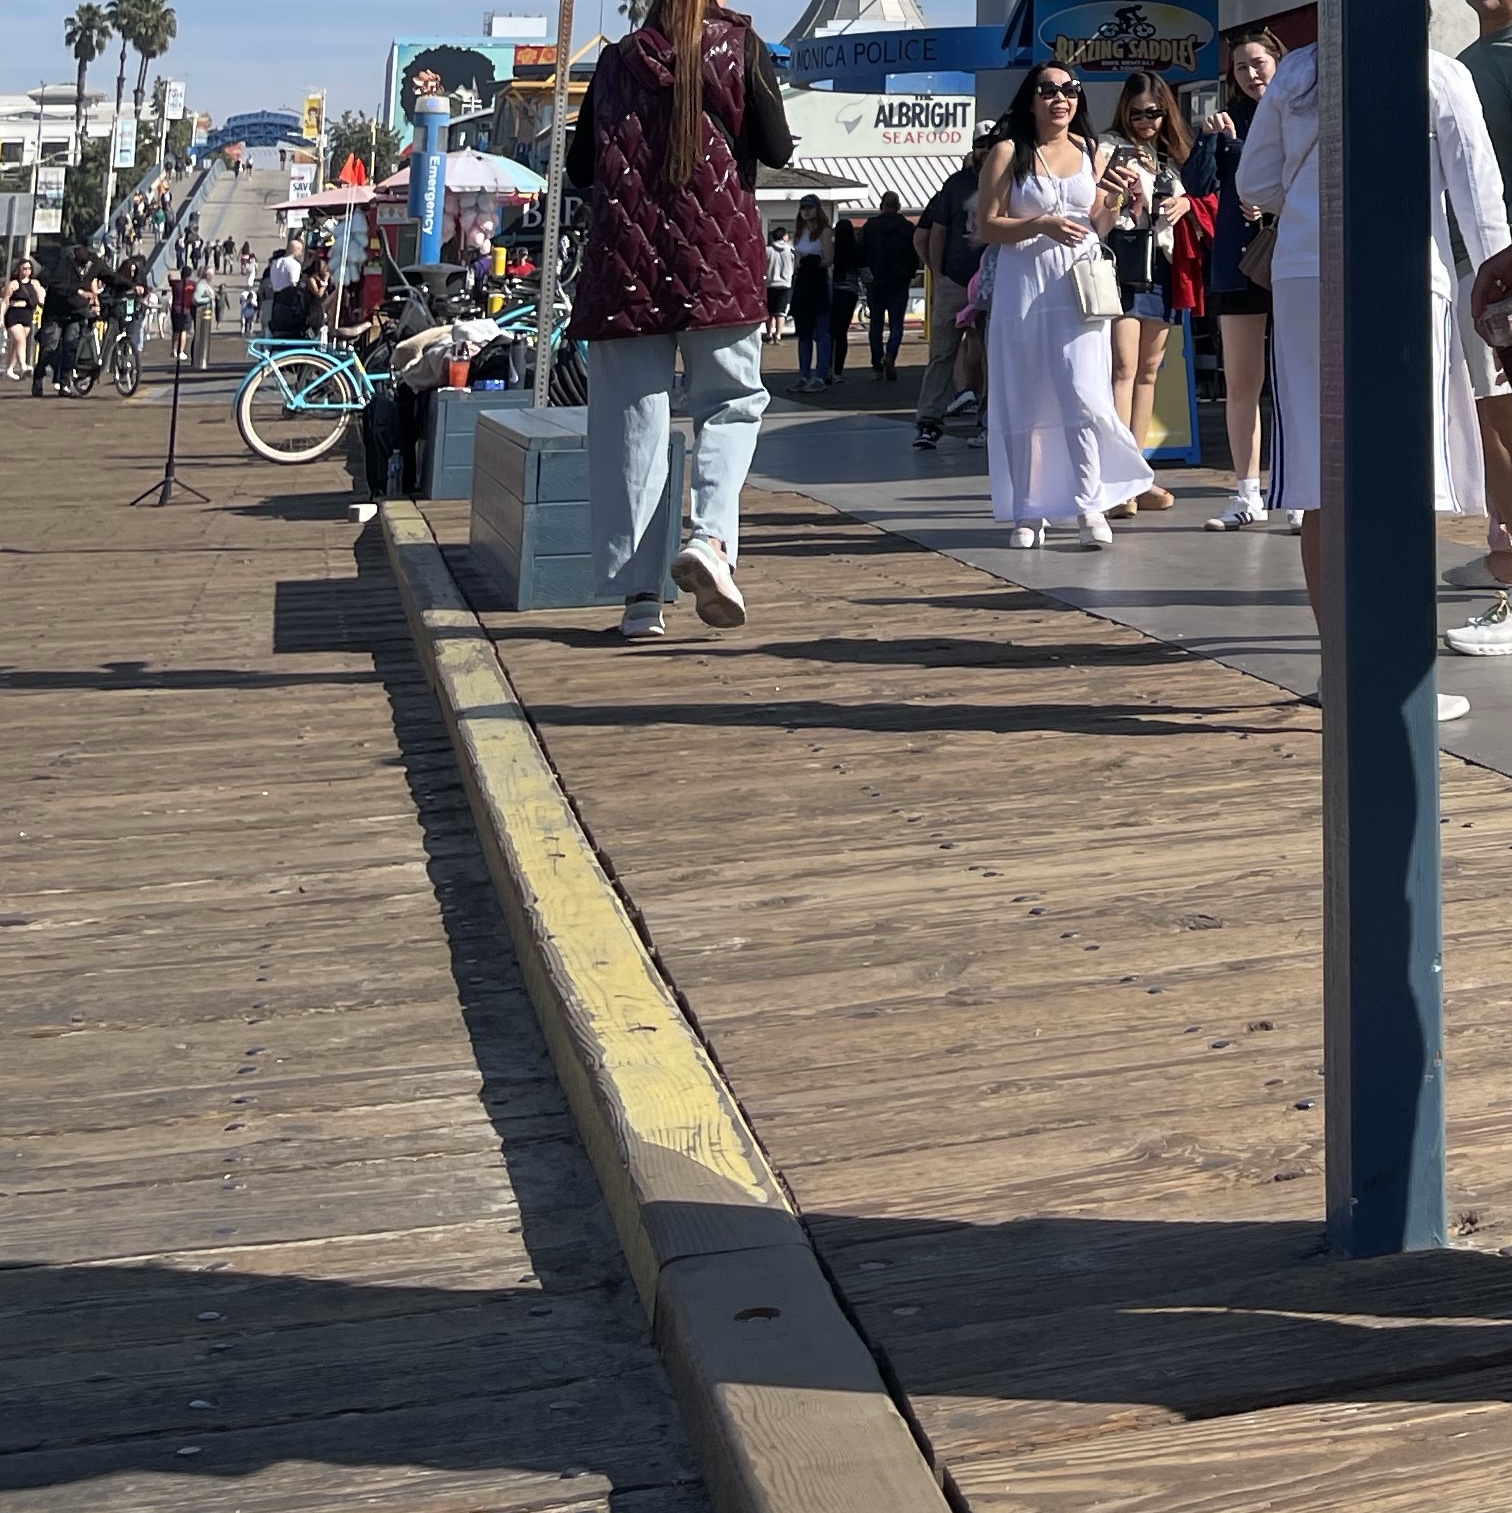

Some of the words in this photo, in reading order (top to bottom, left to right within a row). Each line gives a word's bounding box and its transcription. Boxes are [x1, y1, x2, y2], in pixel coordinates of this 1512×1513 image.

[796, 44, 846, 72] MONICA
[854, 38, 938, 66] POLICE
[1054, 34, 1126, 65] BLAZING
[1128, 34, 1198, 73] SADDLES
[874, 101, 972, 128] ALBRIGHT
[882, 131, 962, 144] SEAFOOD
[422, 155, 440, 235] Emergency
